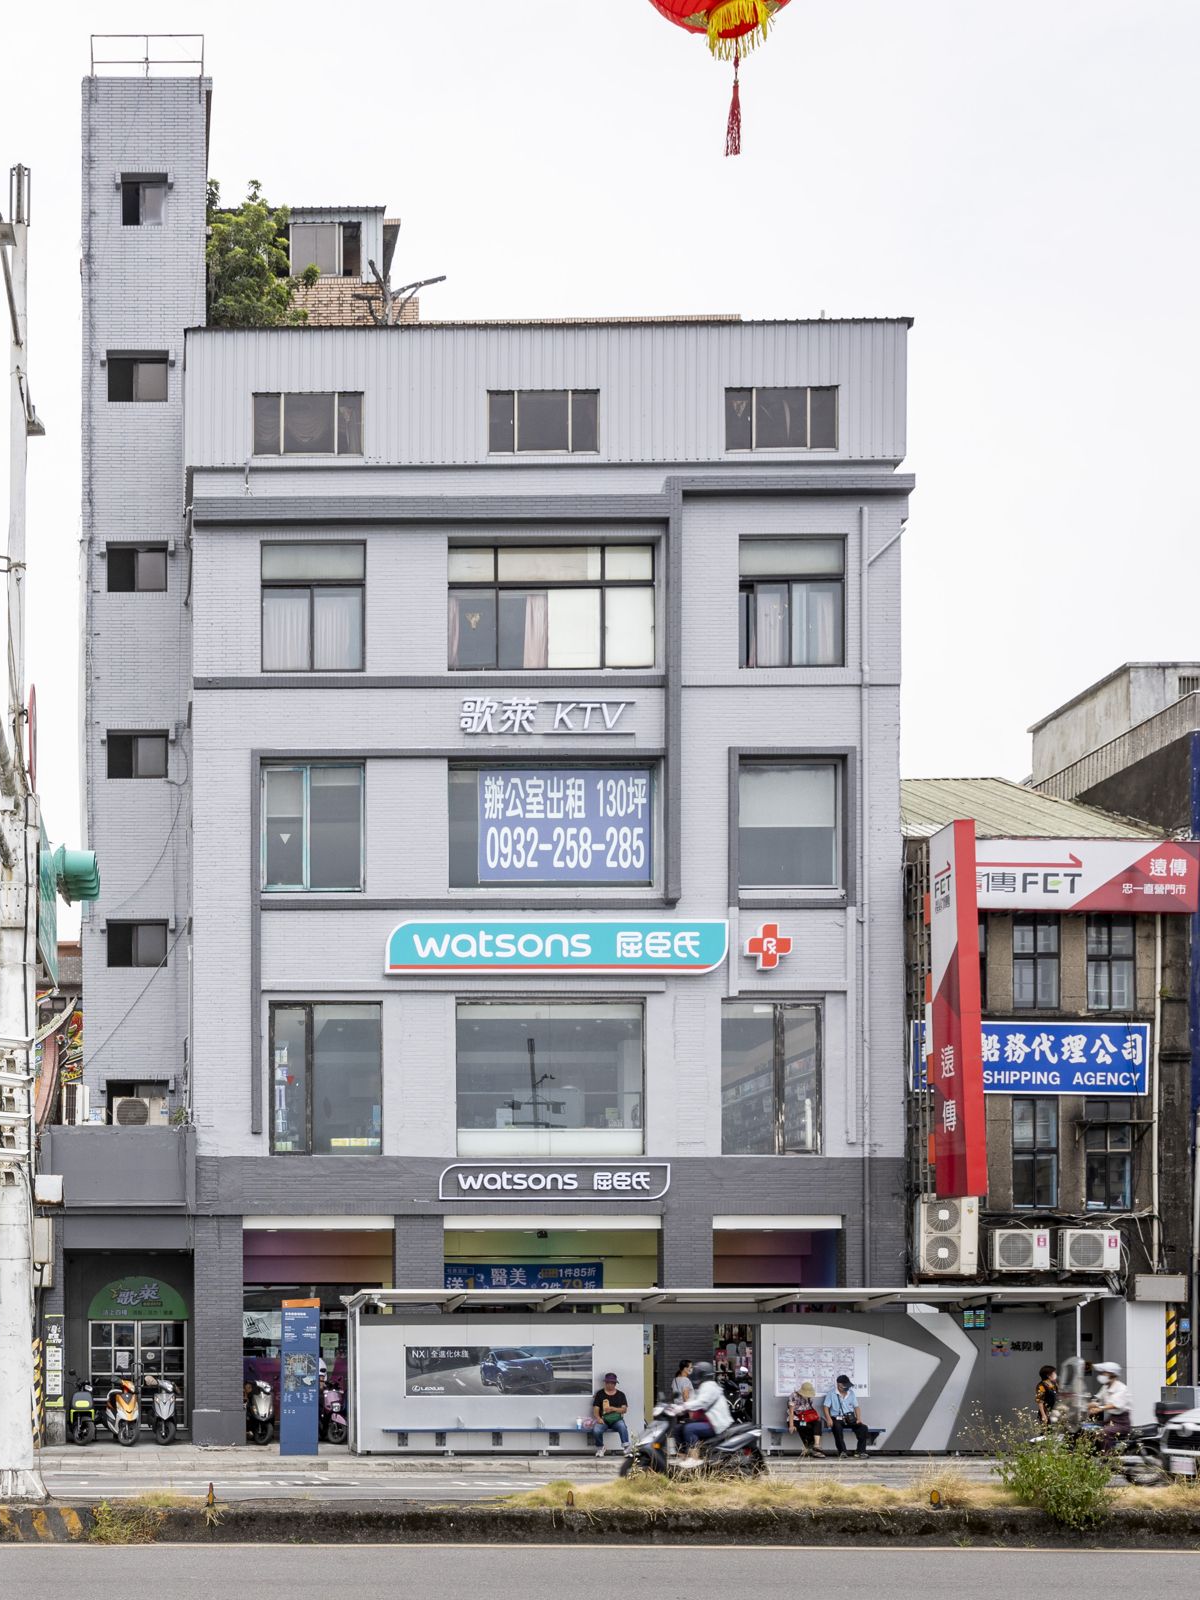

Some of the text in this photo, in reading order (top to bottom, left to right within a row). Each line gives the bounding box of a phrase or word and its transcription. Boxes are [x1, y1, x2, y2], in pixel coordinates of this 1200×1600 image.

[460, 697, 626, 733] 歌萊 KTV
[484, 776, 647, 819] 辦公室出租 130坪
[486, 826, 645, 869] 0932-258-285
[1149, 858, 1187, 877] 遠傳
[1122, 883, 1186, 895] 忠一直營門市
[413, 930, 700, 959] watsons 屈臣氏
[983, 1070, 1141, 1086] SHIPPING AGENCY
[941, 1045, 957, 1134] 遠傳
[457, 1171, 651, 1190] watsons 屈臣氏
[490, 1267, 527, 1286] 醫美
[412, 1350, 425, 1358] NX
